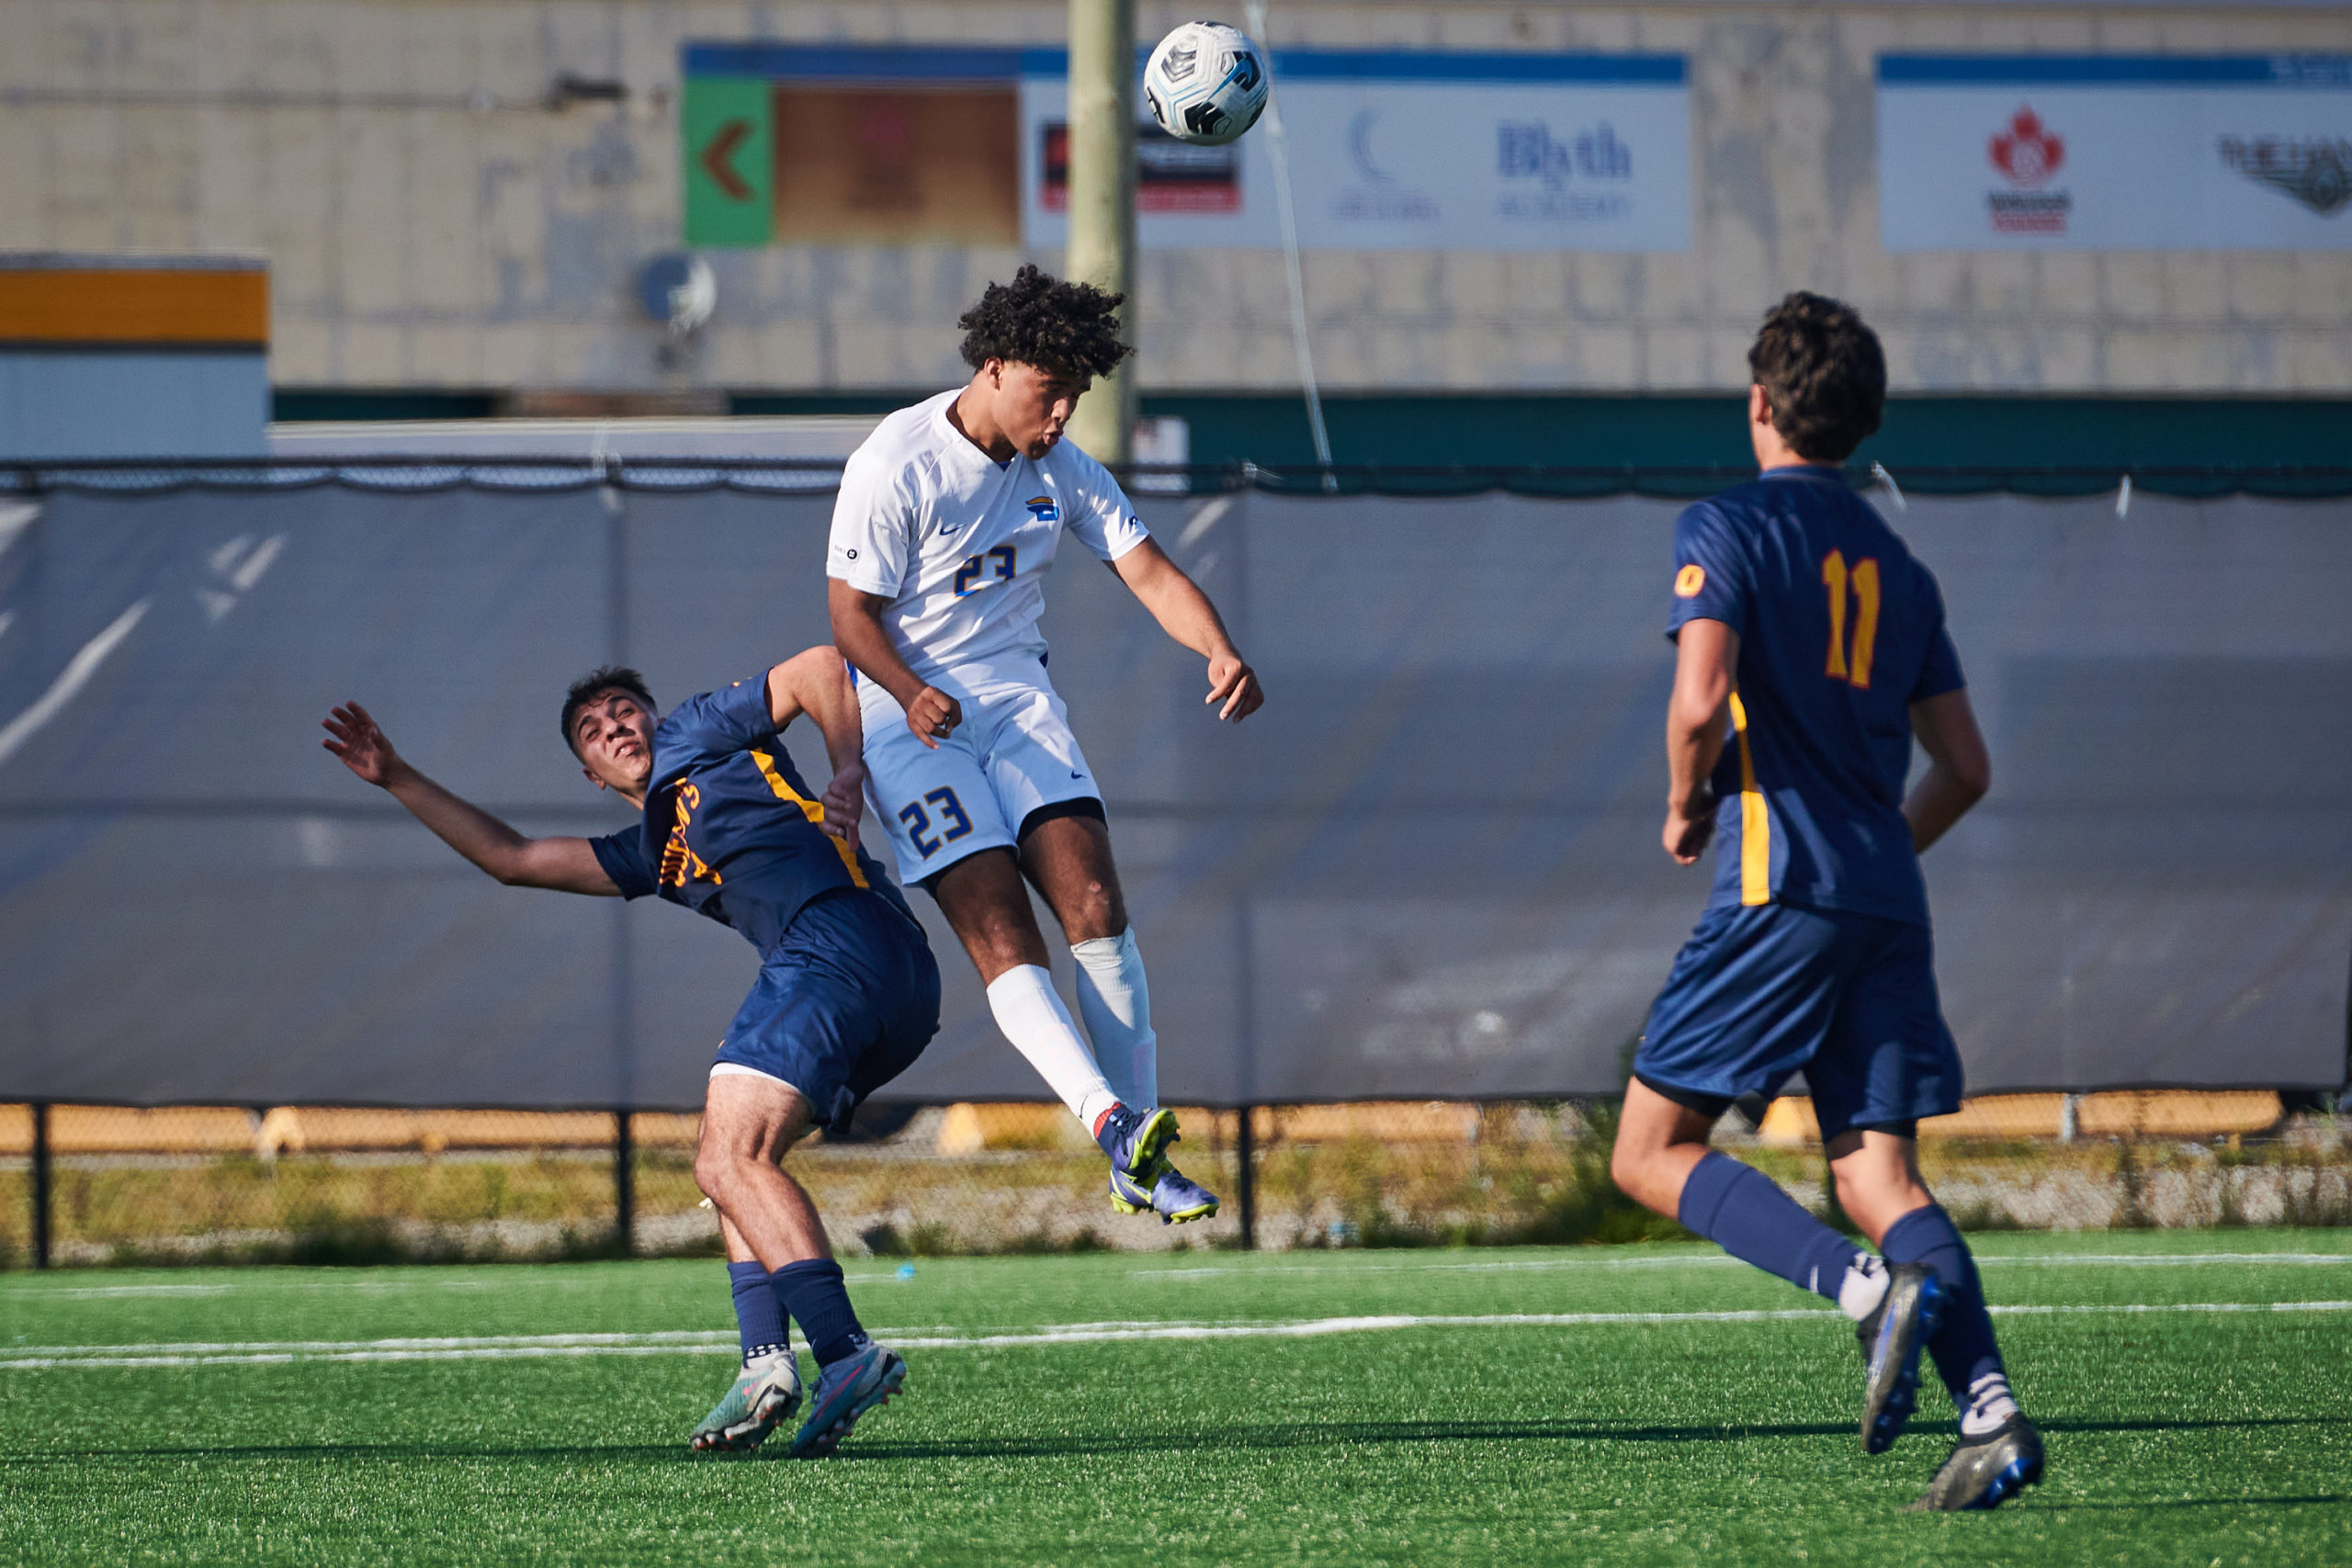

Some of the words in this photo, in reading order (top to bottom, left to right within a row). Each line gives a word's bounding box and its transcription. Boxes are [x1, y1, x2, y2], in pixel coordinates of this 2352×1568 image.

[1497, 120, 1633, 191] Blyth
[954, 545, 1017, 600] 23
[1822, 547, 1882, 689] 11
[898, 784, 974, 861] 23
